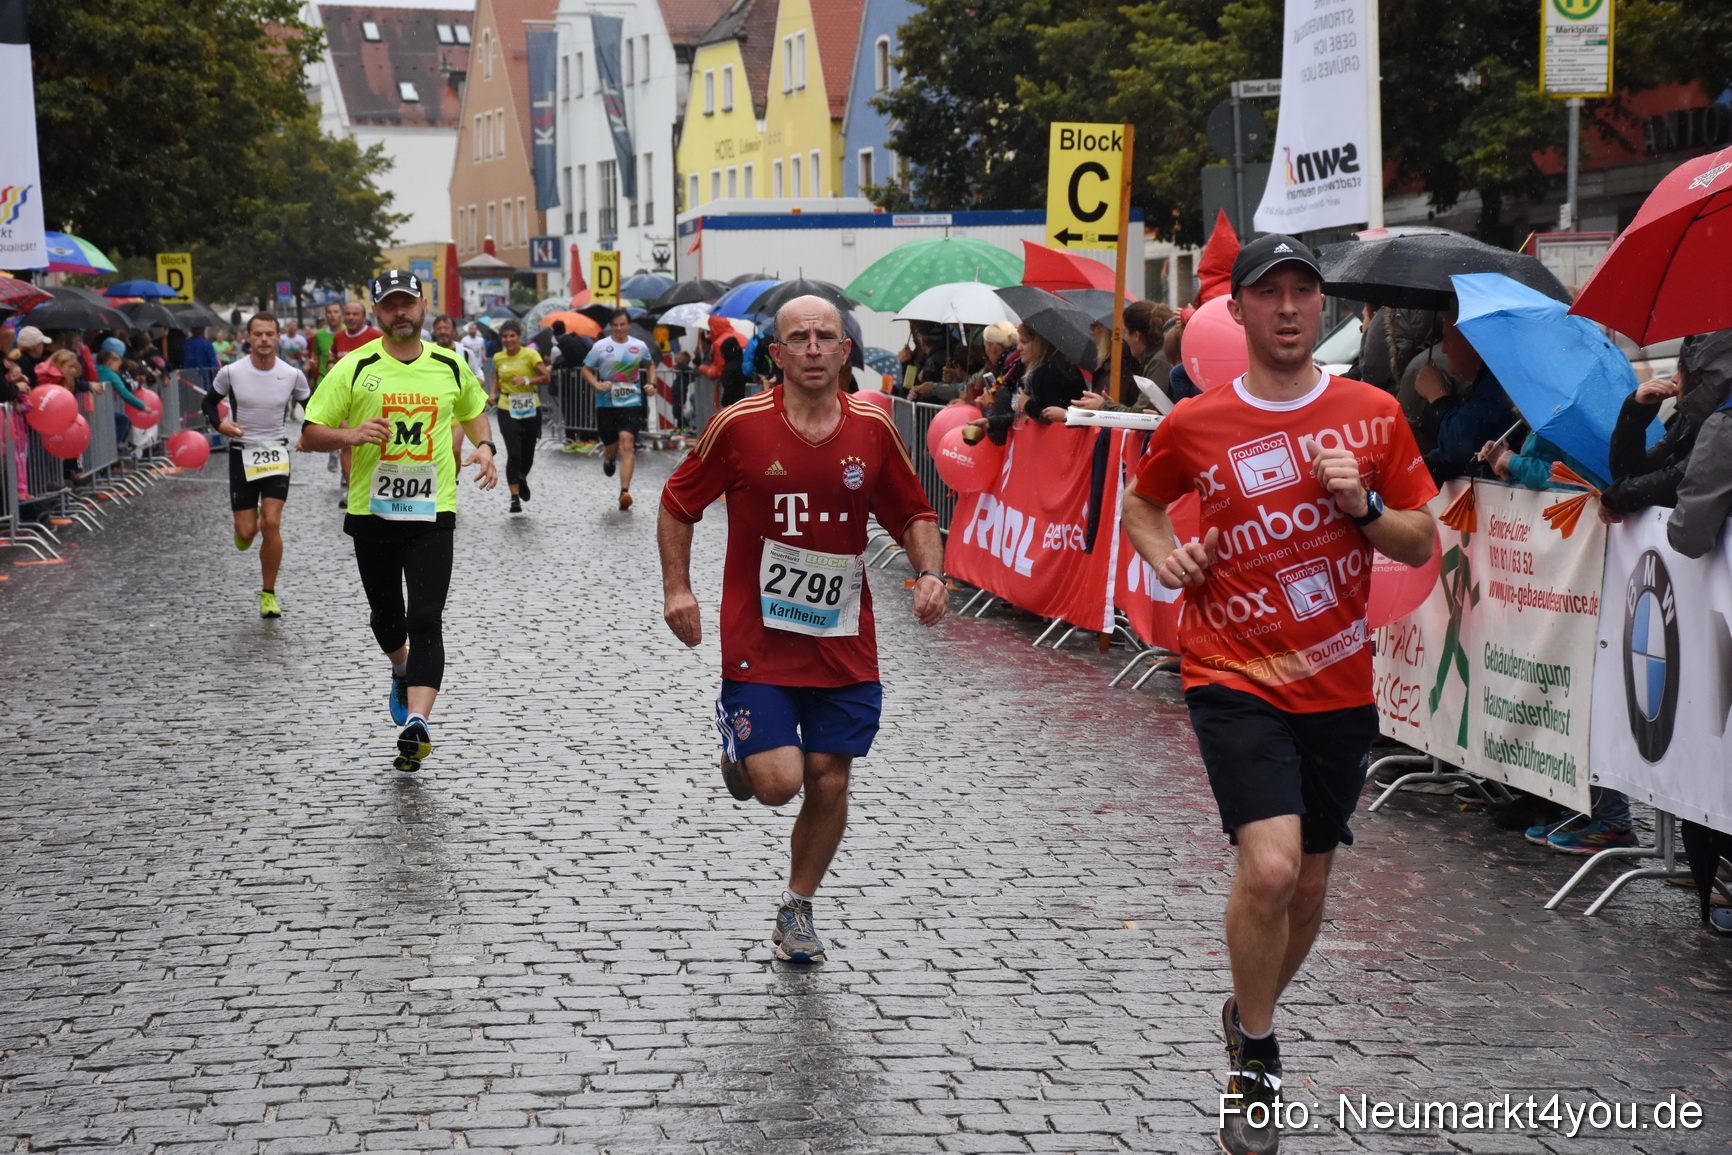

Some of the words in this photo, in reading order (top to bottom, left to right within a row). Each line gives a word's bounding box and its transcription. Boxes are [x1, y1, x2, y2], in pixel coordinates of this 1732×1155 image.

[1555, 25, 1598, 35] Marktplatz
[1243, 84, 1264, 94] Ulmer
[1060, 128, 1123, 152] Block
[1067, 161, 1110, 223] C
[161, 256, 187, 265] Block
[594, 252, 617, 262] Block
[167, 269, 184, 292] D
[598, 266, 614, 289] D
[382, 393, 439, 405] Müller
[512, 398, 535, 410] 2545
[393, 421, 424, 445] M
[252, 450, 280, 465] 238
[1233, 437, 1285, 461] raumbox
[377, 475, 432, 499] 2804
[391, 502, 413, 512] Mike
[1488, 513, 1531, 543] Service-Line:
[770, 550, 800, 563] NeuerMarkt
[1243, 546, 1293, 571] wohnen
[1301, 526, 1348, 551] outdoor
[804, 553, 849, 569] BOCK
[1372, 565, 1409, 573] energie
[1512, 550, 1521, 574] 63
[1523, 551, 1535, 576] 52
[763, 563, 844, 606] 2798
[1281, 562, 1327, 585] raumbox
[1626, 555, 1676, 626] BMW
[769, 602, 827, 626] Karlheinz
[1200, 649, 1307, 680] Team
[1484, 641, 1571, 698] Gebäudereinigung
[1483, 686, 1571, 737] Hausmeisterdienst
